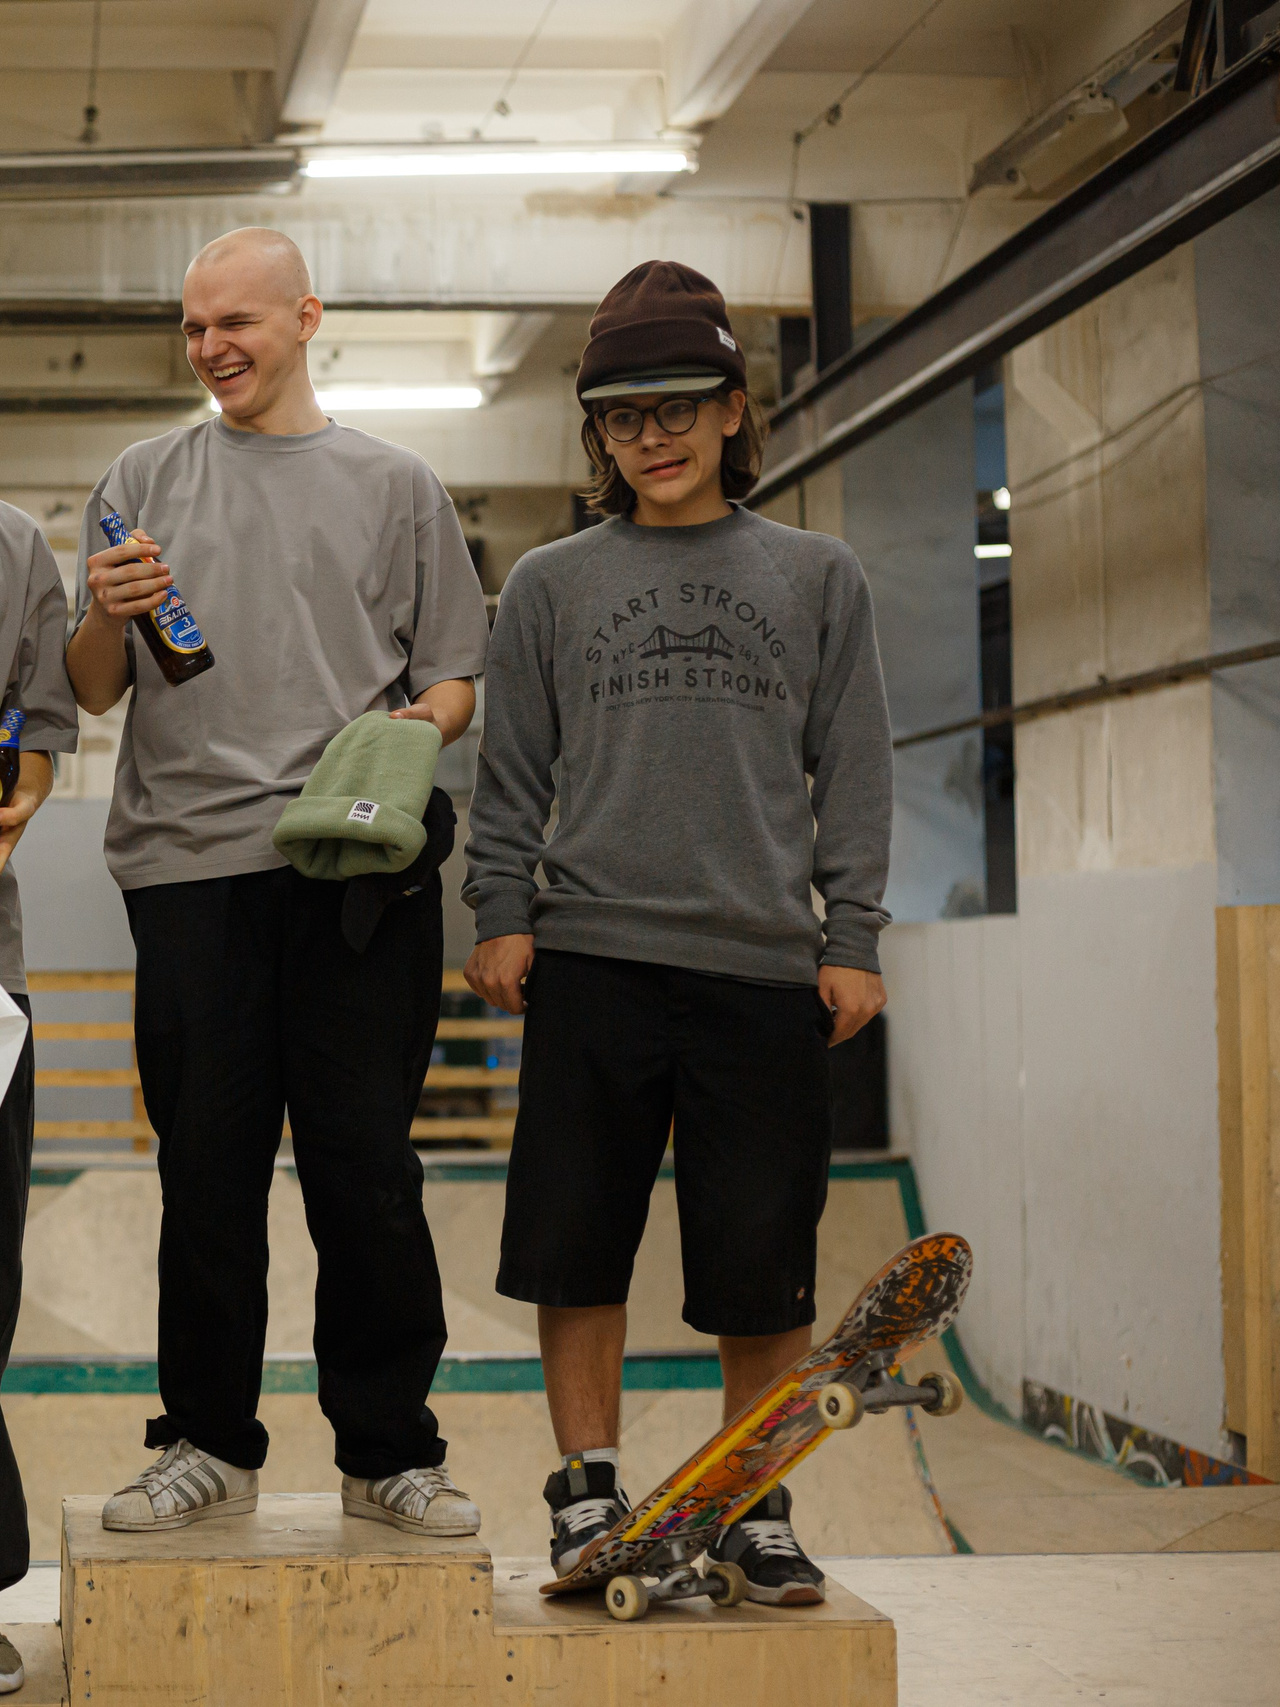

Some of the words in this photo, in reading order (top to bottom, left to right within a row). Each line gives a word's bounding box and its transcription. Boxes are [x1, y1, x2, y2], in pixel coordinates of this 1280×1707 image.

[181, 616, 191, 628] 3
[586, 588, 659, 664] START
[680, 583, 786, 659] STRONG
[613, 643, 635, 664] NYC
[590, 668, 669, 703] FINISH
[685, 668, 787, 701] STRONG
[695, 696, 736, 704] MARATHON
